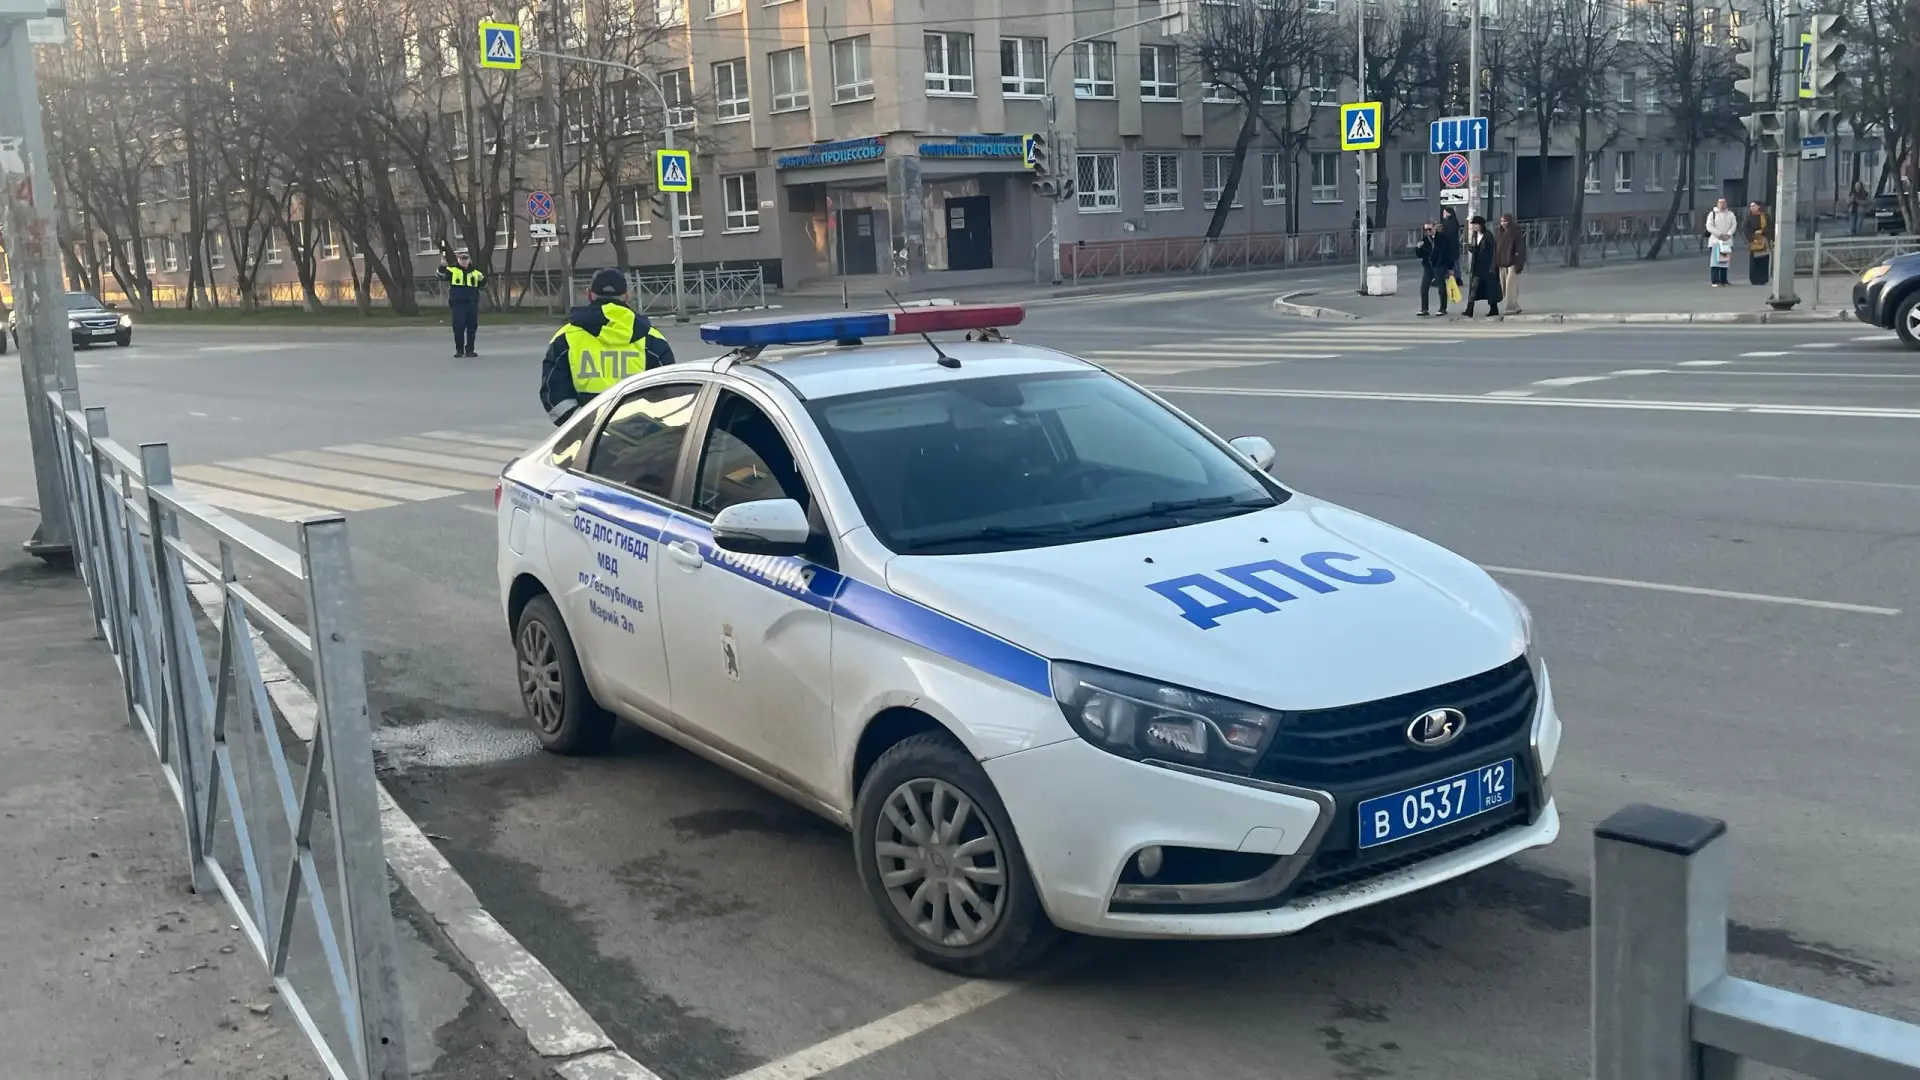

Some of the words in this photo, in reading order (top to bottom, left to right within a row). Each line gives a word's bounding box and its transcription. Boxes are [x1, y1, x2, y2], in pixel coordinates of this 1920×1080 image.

[821, 146, 877, 164] ПРОЦЕССОВ
[972, 142, 1023, 157] ПРОЦЕССО
[577, 350, 640, 379] ДПС
[573, 515, 591, 535] ОСБ
[592, 522, 613, 544] ДПС
[614, 530, 649, 562] ГИБДД
[597, 551, 618, 578] МВД
[578, 571, 590, 586] по
[589, 573, 644, 613] Республике
[1144, 551, 1396, 631] ДПС
[588, 598, 619, 627] Марий
[620, 614, 635, 635] Эл
[1374, 809, 1391, 839] В
[1402, 778, 1467, 830] 0537
[1482, 765, 1506, 795] 12
[1485, 792, 1503, 807] RUS
